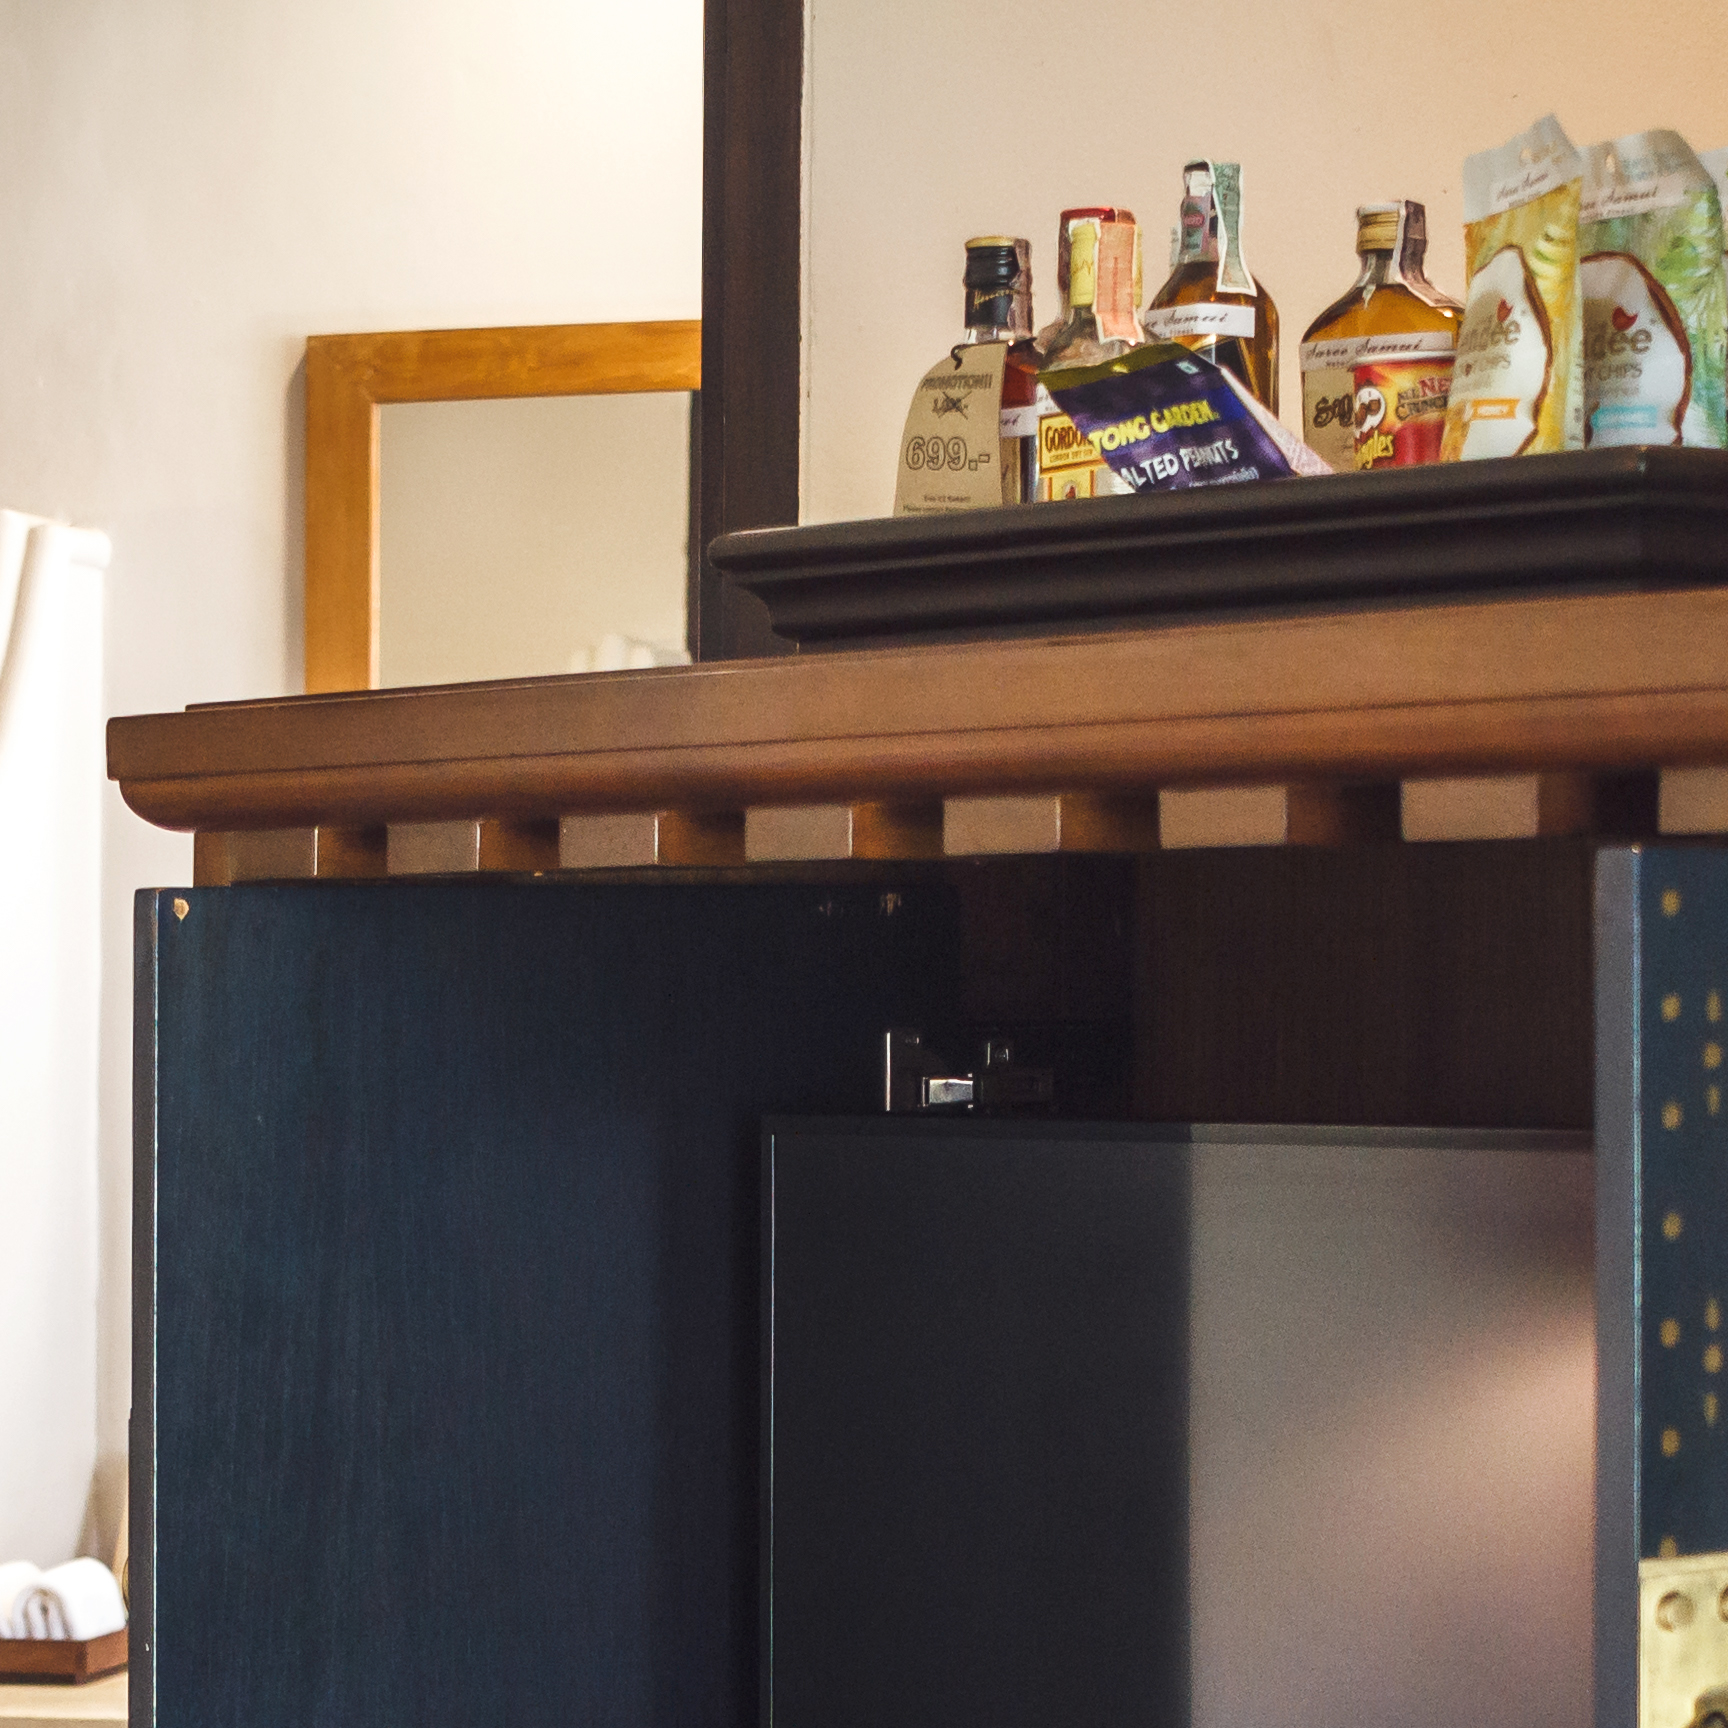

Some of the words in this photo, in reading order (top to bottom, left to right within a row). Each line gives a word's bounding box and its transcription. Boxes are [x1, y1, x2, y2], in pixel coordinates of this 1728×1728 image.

[1419, 376, 1453, 397] NE
[1088, 416, 1151, 453] TONG
[1150, 400, 1218, 434] GARDEN
[906, 436, 990, 471] 699.-
[1120, 452, 1179, 487] ALTED
[1179, 438, 1239, 471] PEANUTS
